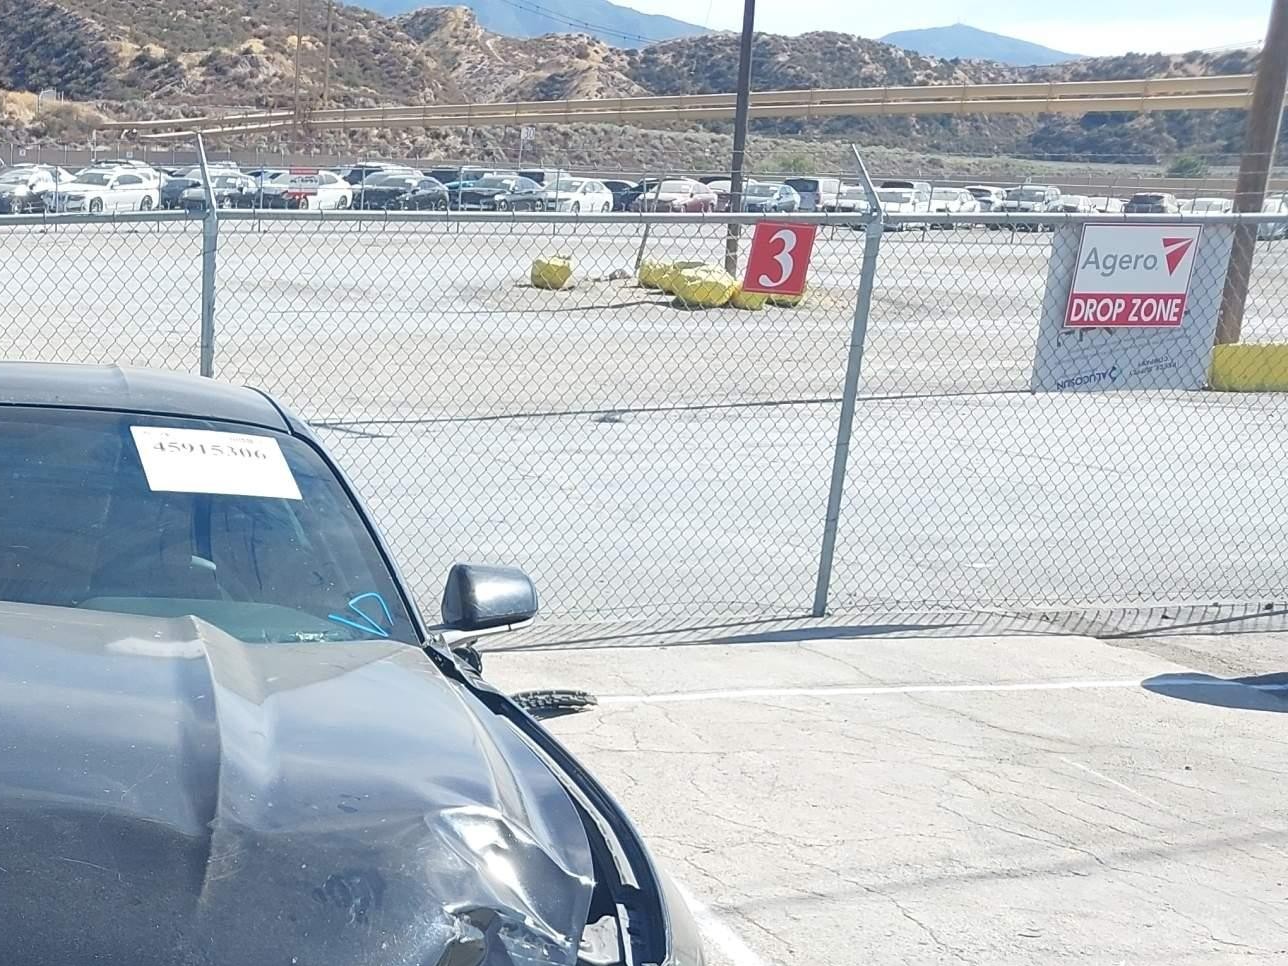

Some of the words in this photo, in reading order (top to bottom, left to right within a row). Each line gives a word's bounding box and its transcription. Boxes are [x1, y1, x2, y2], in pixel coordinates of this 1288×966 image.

[758, 229, 797, 287] 3
[1081, 247, 1158, 277] Agero
[1070, 298, 1125, 322] DROP
[1128, 299, 1182, 322] ZONE
